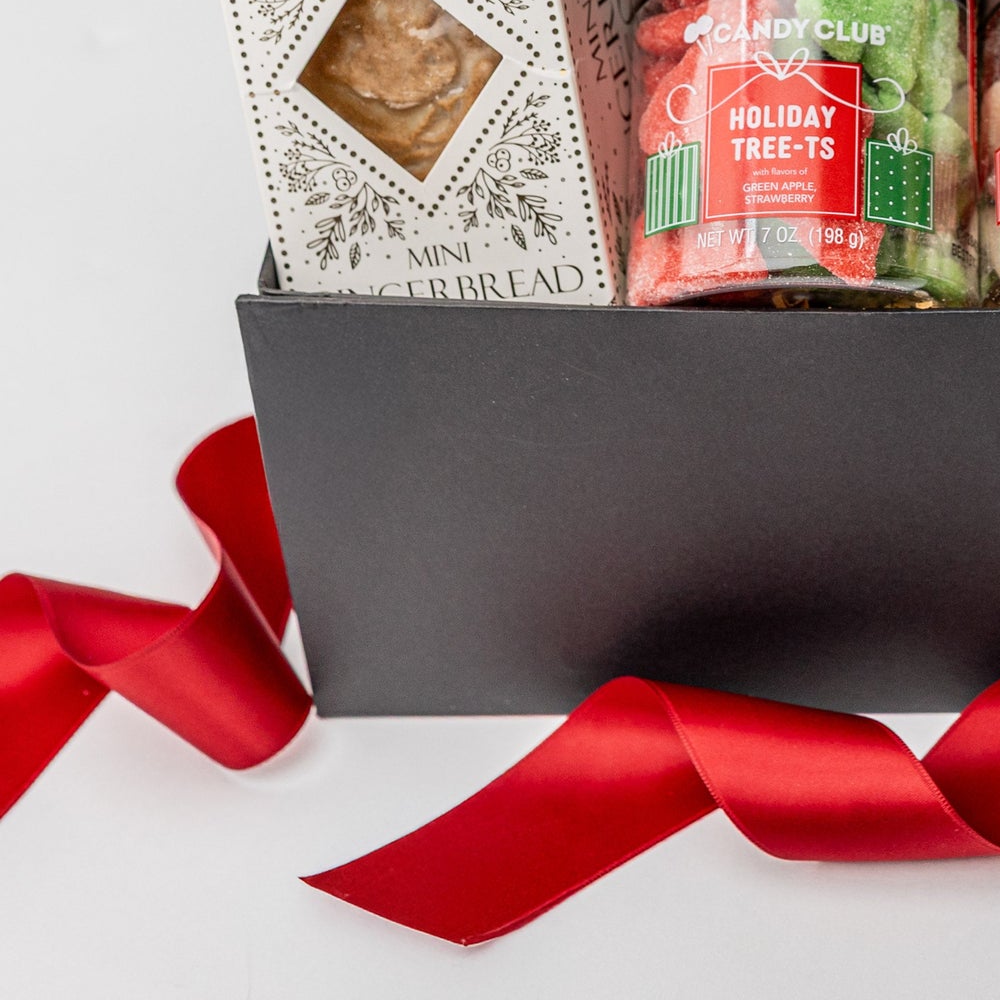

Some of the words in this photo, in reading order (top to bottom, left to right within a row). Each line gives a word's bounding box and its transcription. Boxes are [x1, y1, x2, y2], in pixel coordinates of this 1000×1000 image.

[713, 18, 811, 44] CANDY
[729, 105, 837, 130] HOLIDAY
[730, 136, 836, 162] TREE-TS
[752, 168, 770, 177] with
[771, 167, 797, 177] flavors
[798, 167, 808, 176] of
[742, 182, 779, 193] GREEN
[781, 181, 817, 193] APPLE,
[744, 194, 815, 204] STRAWBERRY
[697, 231, 725, 248] NET
[761, 227, 771, 243] 7
[808, 226, 844, 247] (198
[849, 230, 865, 249] g)
[407, 242, 472, 270] MINI
